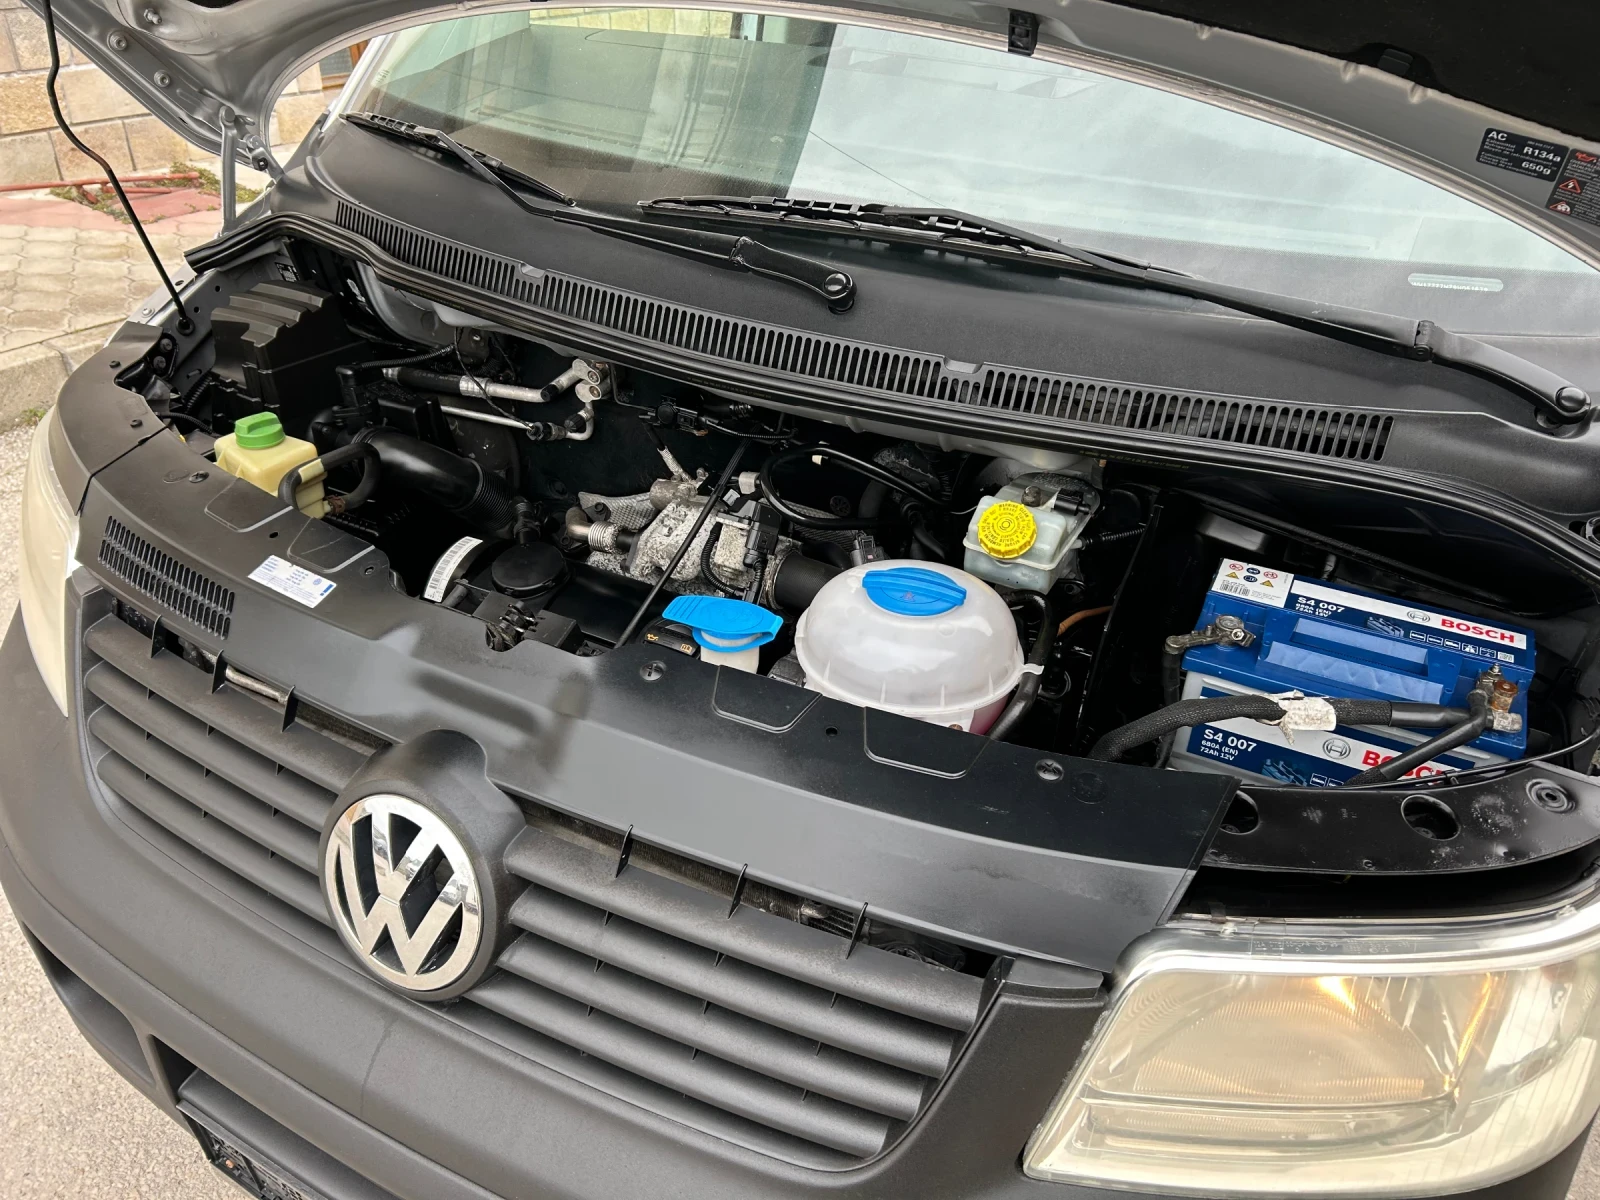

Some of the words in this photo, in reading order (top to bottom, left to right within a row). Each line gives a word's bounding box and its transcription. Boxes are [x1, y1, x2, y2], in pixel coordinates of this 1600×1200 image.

[1488, 131, 1507, 141] AC
[1523, 146, 1561, 162] R134a
[1522, 161, 1551, 175] 650g
[1297, 597, 1315, 606] S4
[1319, 602, 1345, 612] 007
[1441, 619, 1514, 643] BOSCH
[1201, 740, 1219, 749] 680A
[1222, 746, 1238, 756] (EN)
[1204, 729, 1223, 743] S4
[1228, 736, 1257, 752] 007
[1200, 746, 1219, 756] 72Ah
[1220, 753, 1234, 761] 12V
[324, 793, 484, 992] VW
